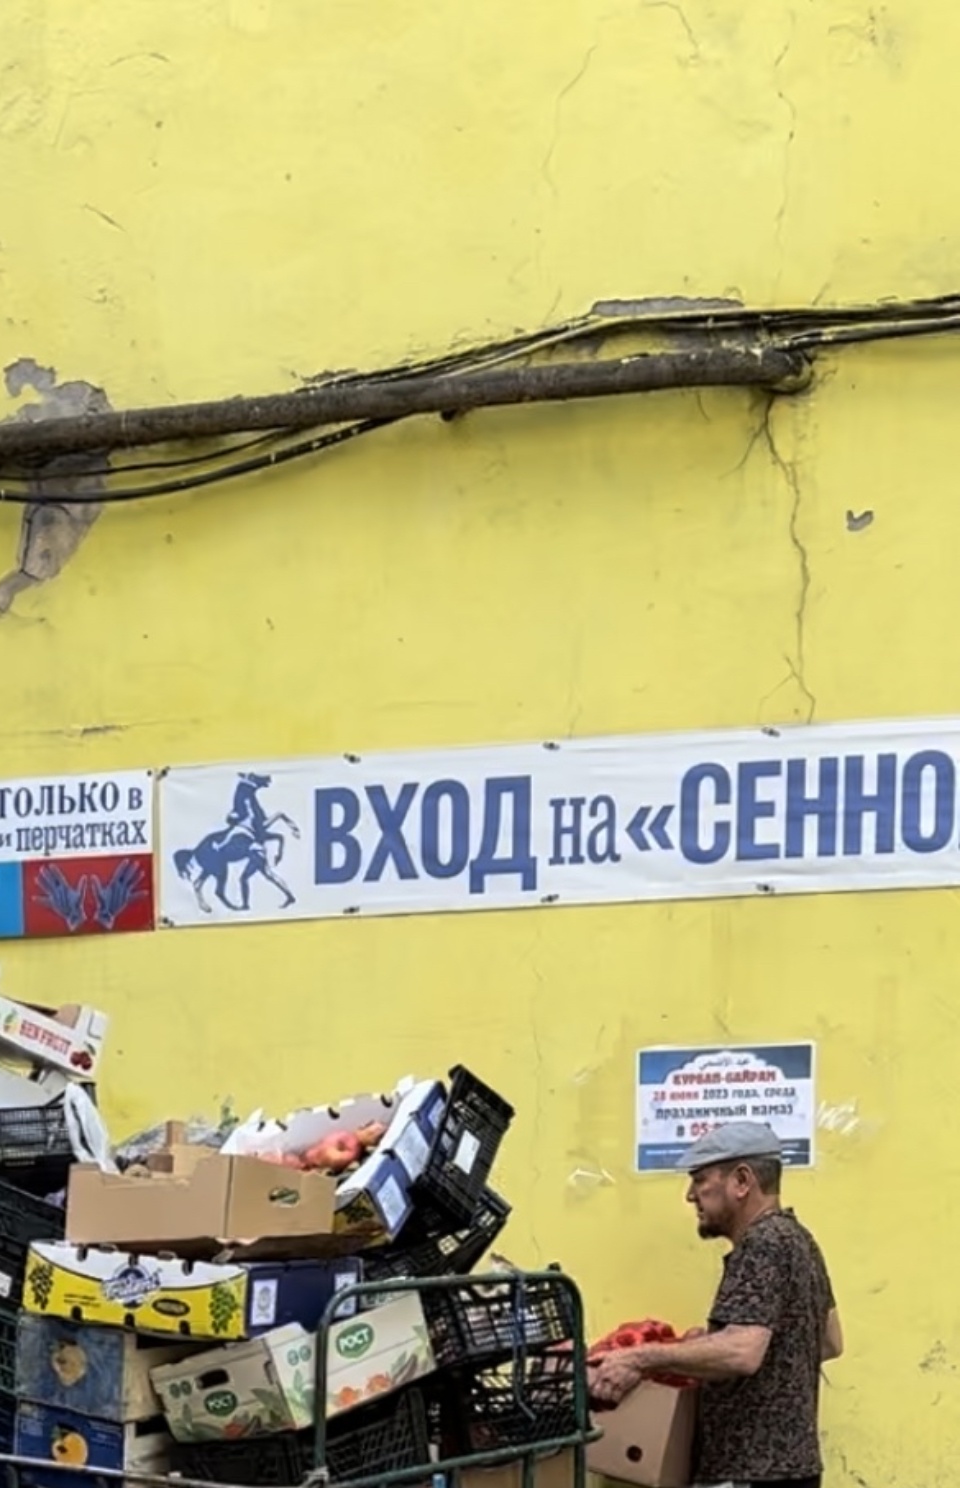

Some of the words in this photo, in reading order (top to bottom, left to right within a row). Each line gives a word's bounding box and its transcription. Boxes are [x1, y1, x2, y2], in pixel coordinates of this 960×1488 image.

[128, 787, 143, 811] в
[314, 775, 537, 895] ВХОД
[548, 795, 622, 866] на
[625, 749, 960, 864] «СЕННО
[16, 820, 148, 857] перчатках
[702, 1088, 729, 1100] 2023
[764, 1086, 796, 1098] среда
[655, 1104, 747, 1120] праздничный
[751, 1104, 793, 1116] намаз
